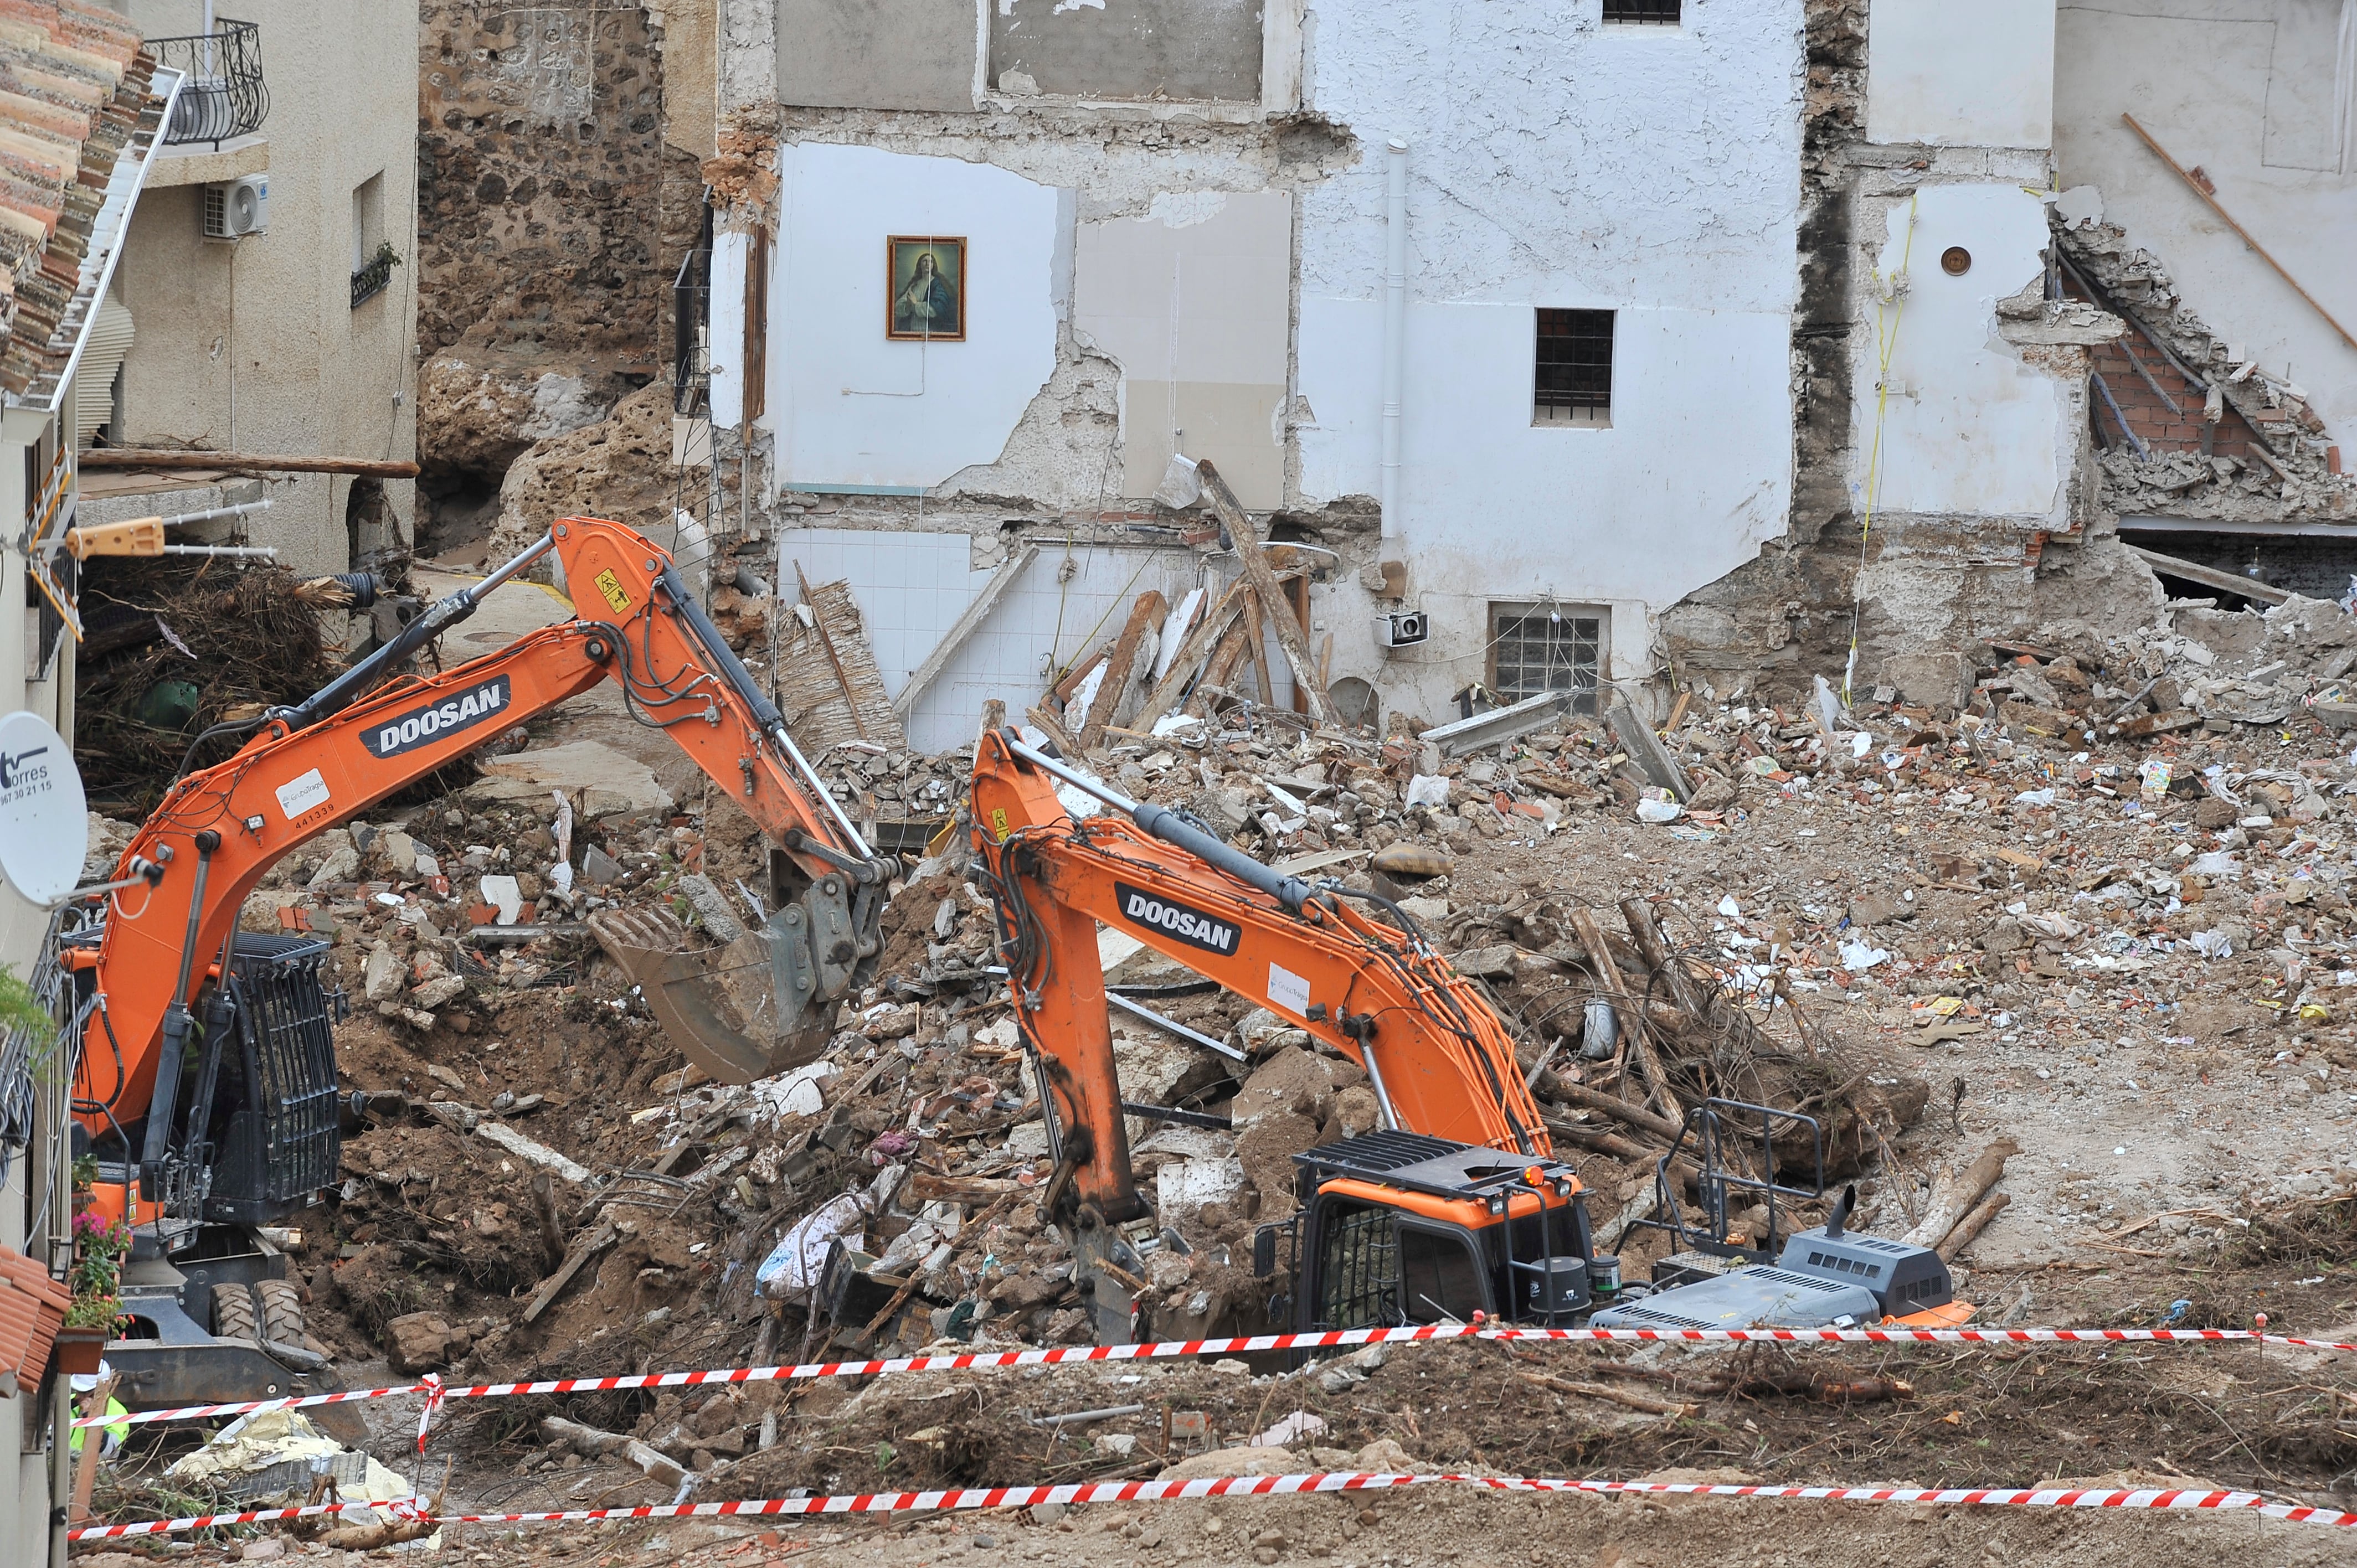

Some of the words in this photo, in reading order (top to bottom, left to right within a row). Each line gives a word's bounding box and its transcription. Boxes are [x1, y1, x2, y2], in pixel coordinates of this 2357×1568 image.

[380, 684, 500, 753] DOOSAN
[0, 792, 12, 806] 967
[14, 788, 24, 800] 30
[27, 785, 36, 796] 21
[40, 781, 52, 791] 15
[296, 803, 334, 829] 441339
[1127, 894, 1232, 951] DOOSAN
